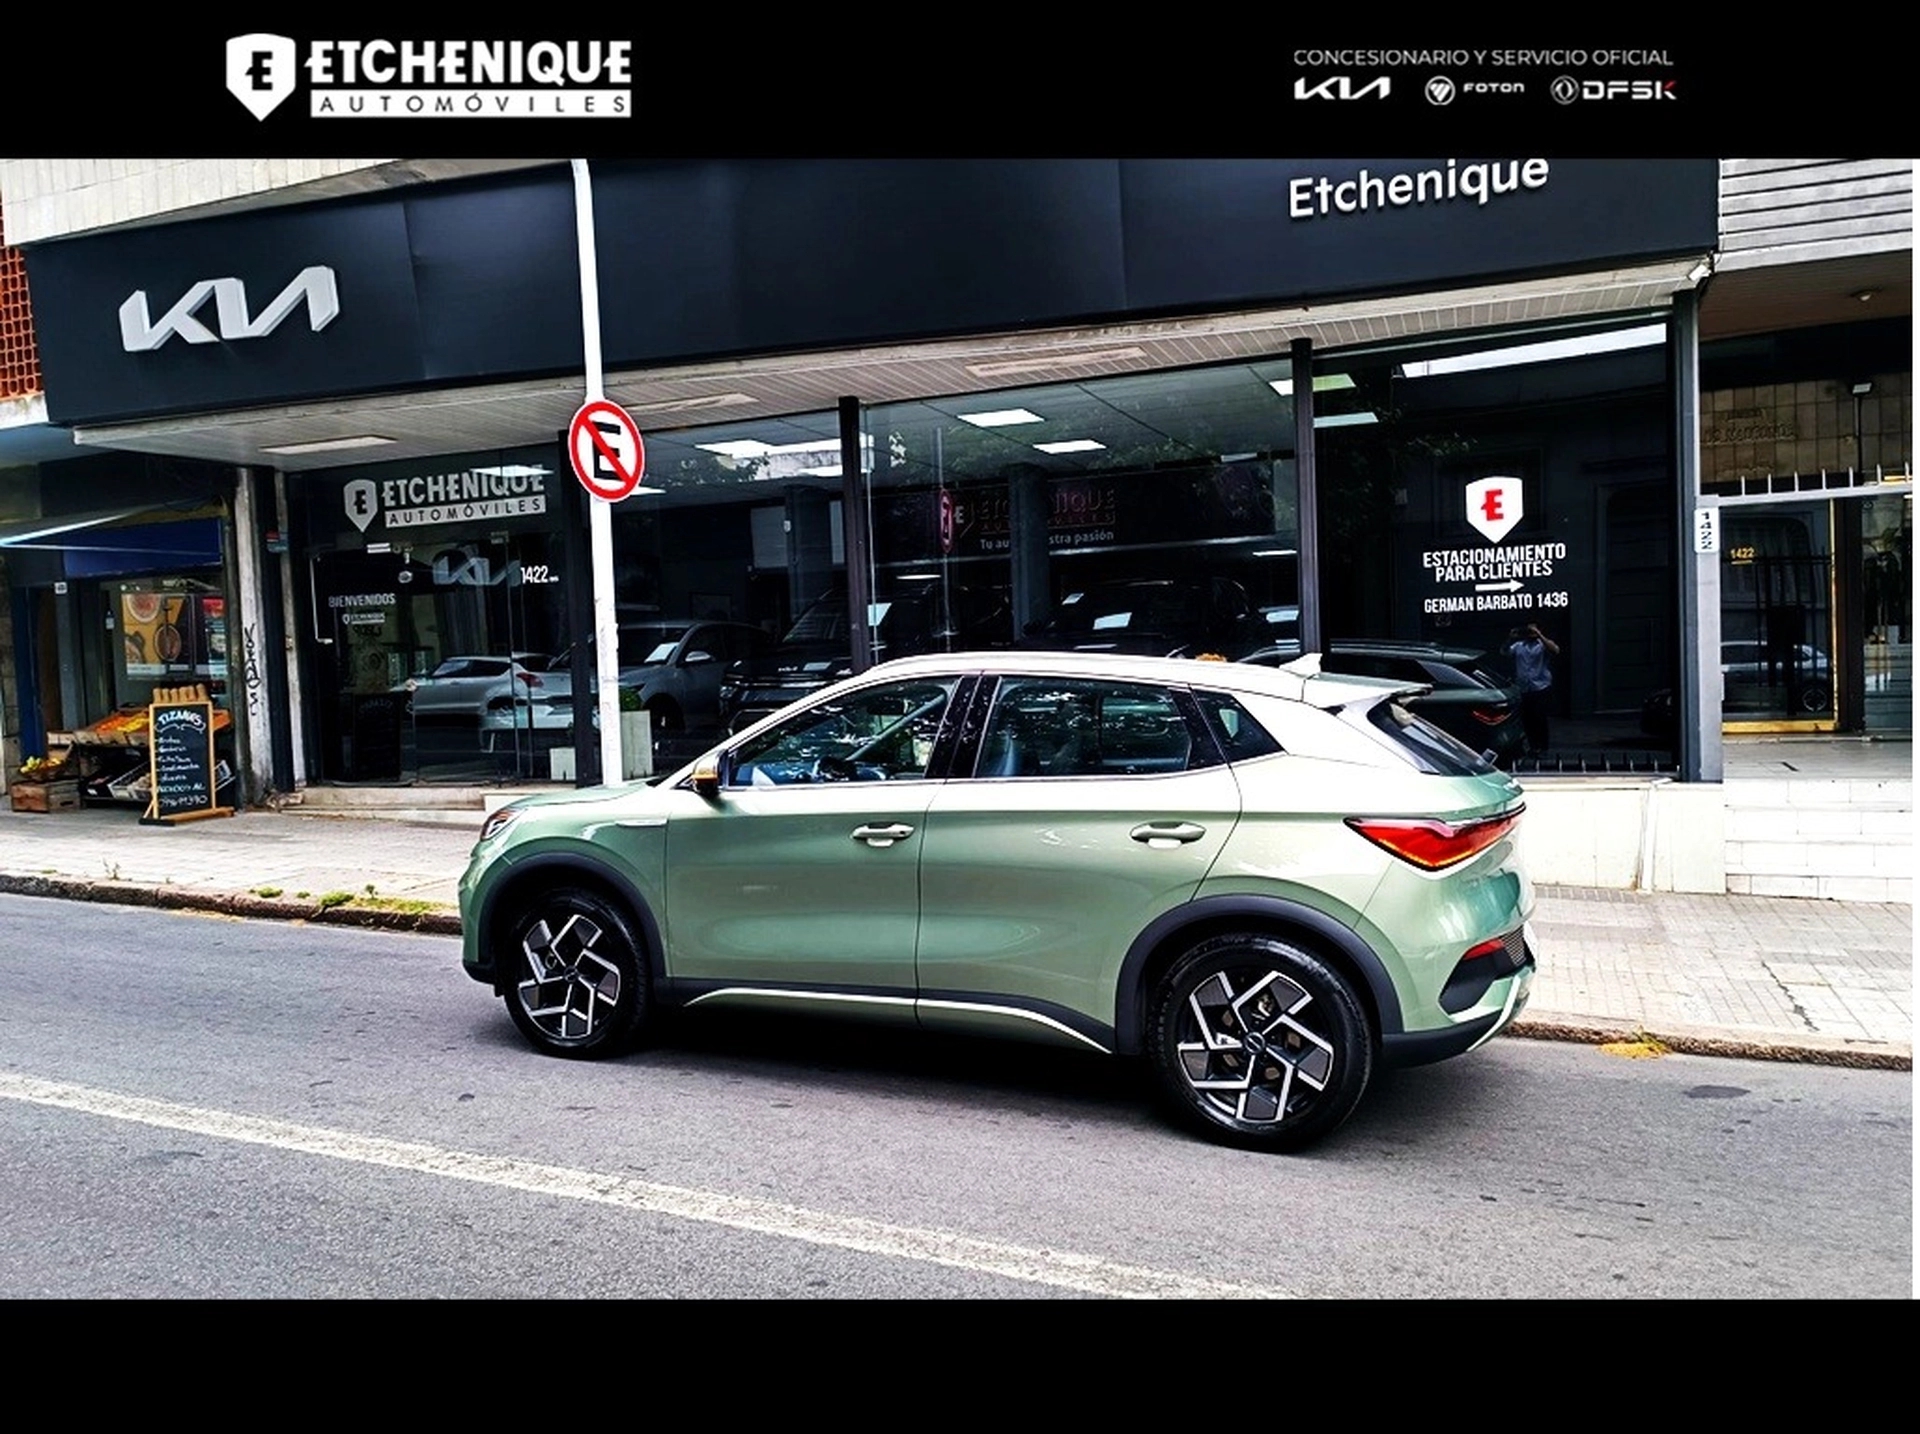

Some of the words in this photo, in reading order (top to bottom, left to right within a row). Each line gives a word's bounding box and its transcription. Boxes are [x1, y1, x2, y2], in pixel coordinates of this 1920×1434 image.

[1289, 158, 1550, 217] Etchenique
[119, 265, 340, 352] KIA
[382, 464, 545, 507] ETCHENIQUE
[389, 498, 541, 525] AUTOMÓVILES
[1481, 489, 1504, 521] E
[1074, 529, 1114, 545] pasión
[1700, 511, 1712, 550] 1422
[1423, 543, 1566, 568] ESTACIONAMIENTO
[1730, 547, 1755, 559] 1422
[520, 565, 549, 584] 1422
[1435, 565, 1476, 582] PARA
[1479, 560, 1553, 580] CLIENTES
[328, 592, 396, 608] BIENVENIDOS
[1424, 597, 1474, 613] GERMAN
[1476, 593, 1533, 611] BARBATO
[1537, 592, 1569, 608] 1436
